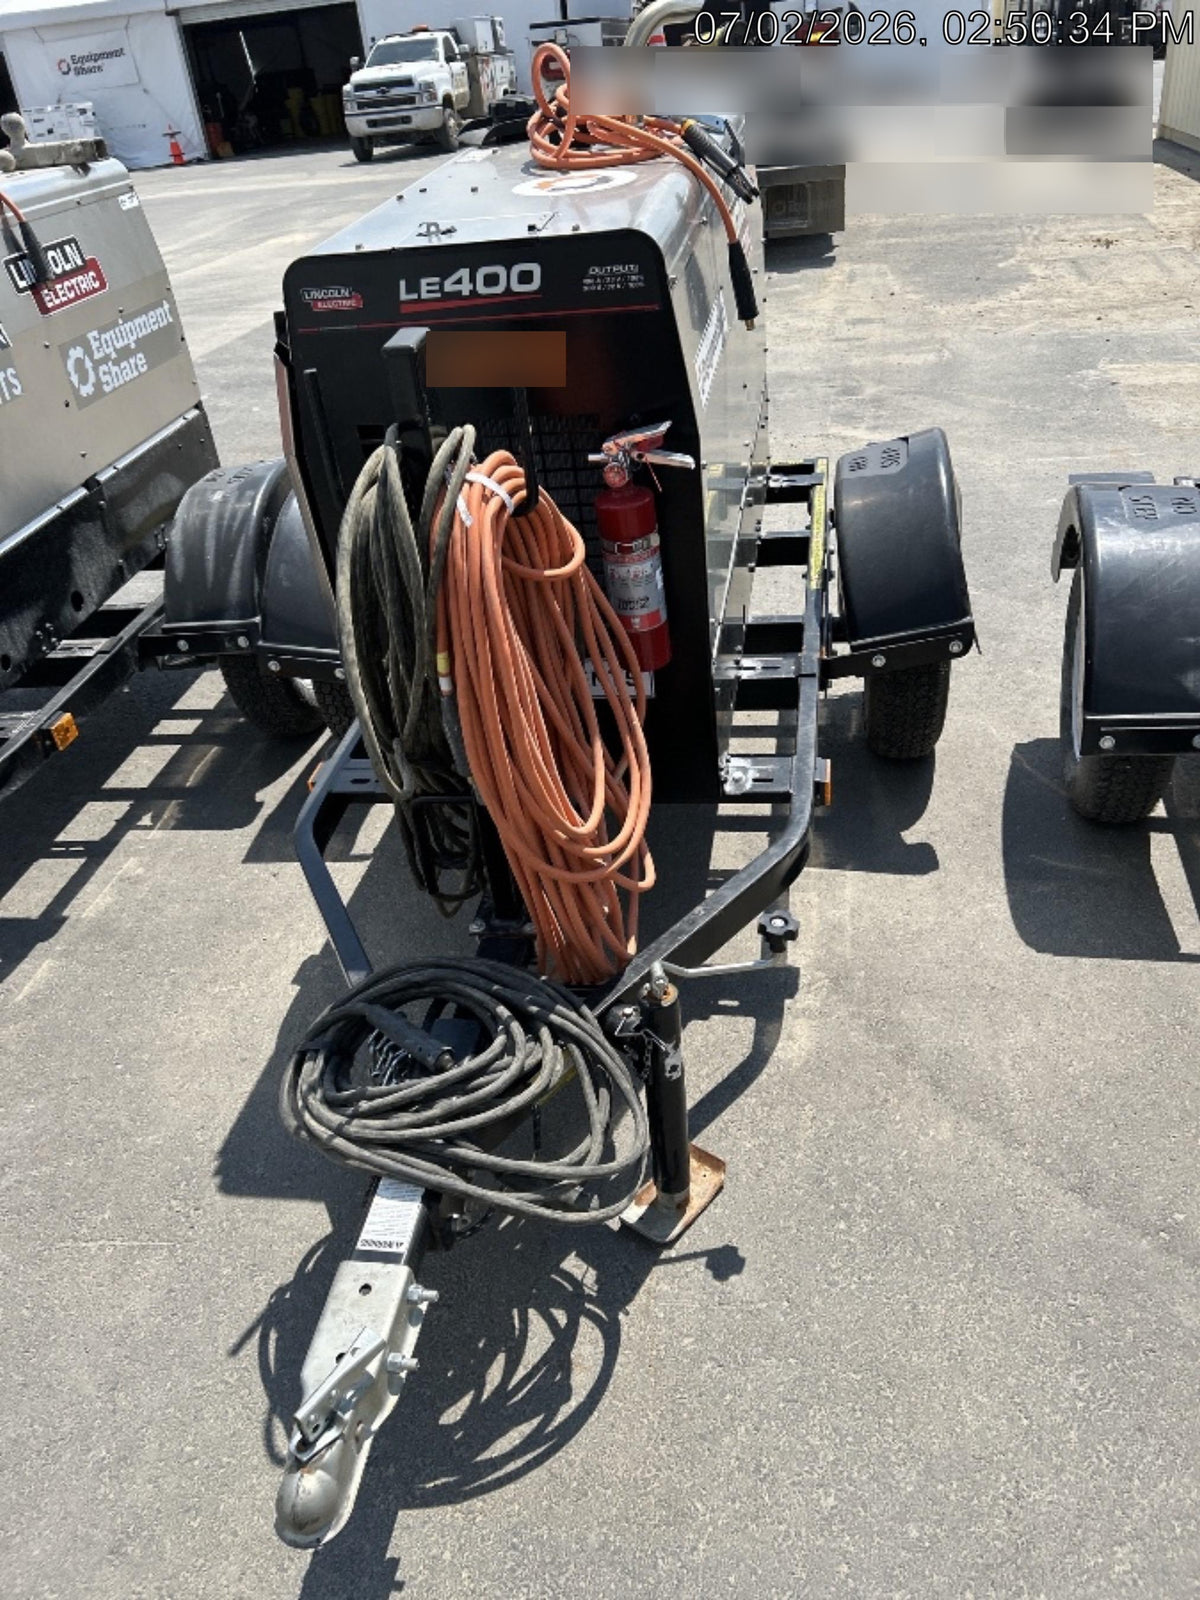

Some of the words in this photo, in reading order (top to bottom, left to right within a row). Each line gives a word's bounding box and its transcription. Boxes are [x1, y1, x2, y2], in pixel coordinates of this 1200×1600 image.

[41, 271, 101, 309] ELECTRIC
[399, 262, 542, 301] LE400
[86, 299, 174, 360] Equipment
[98, 351, 149, 394] Share
